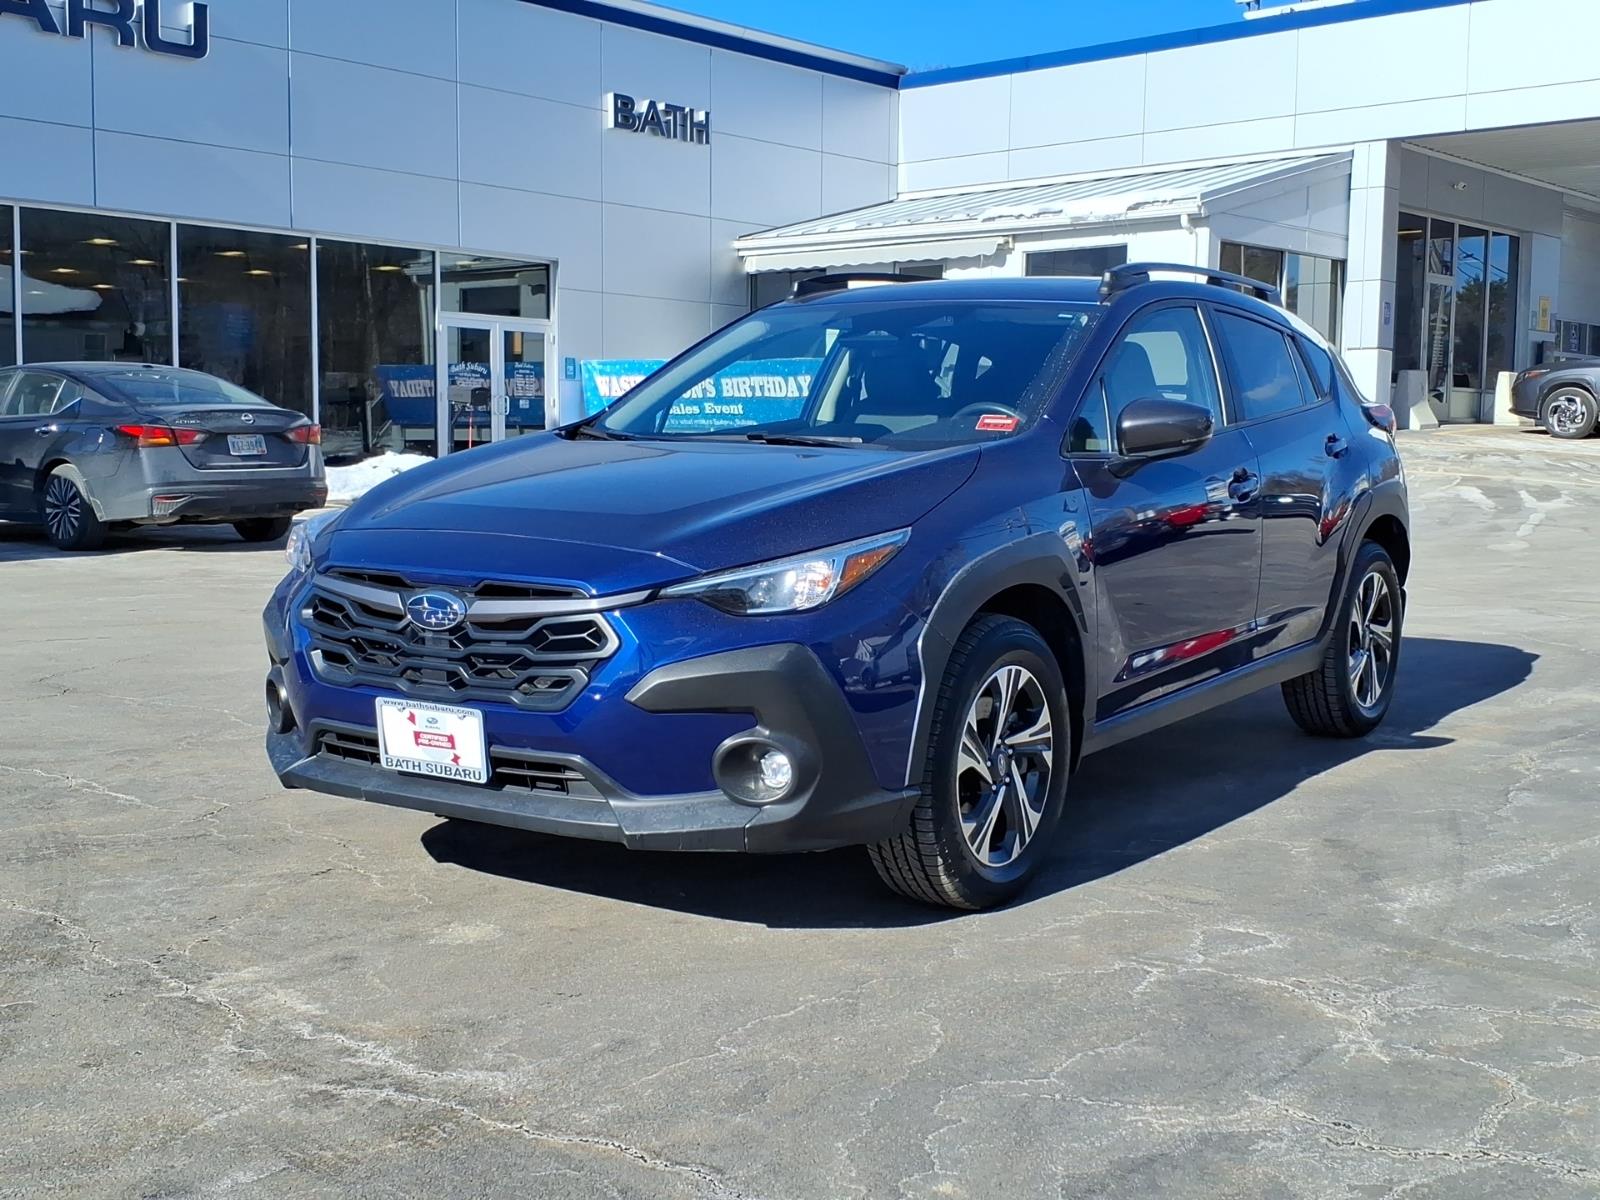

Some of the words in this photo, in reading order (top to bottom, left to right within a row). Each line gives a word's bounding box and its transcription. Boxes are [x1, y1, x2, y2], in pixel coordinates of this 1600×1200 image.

[608, 92, 710, 145] BATH
[721, 375, 811, 398] BIRTHDAY
[704, 402, 744, 415] Event
[383, 699, 475, 716] www.bathsubaru.com
[385, 757, 421, 772] BATH
[425, 763, 482, 781] SUBARU
